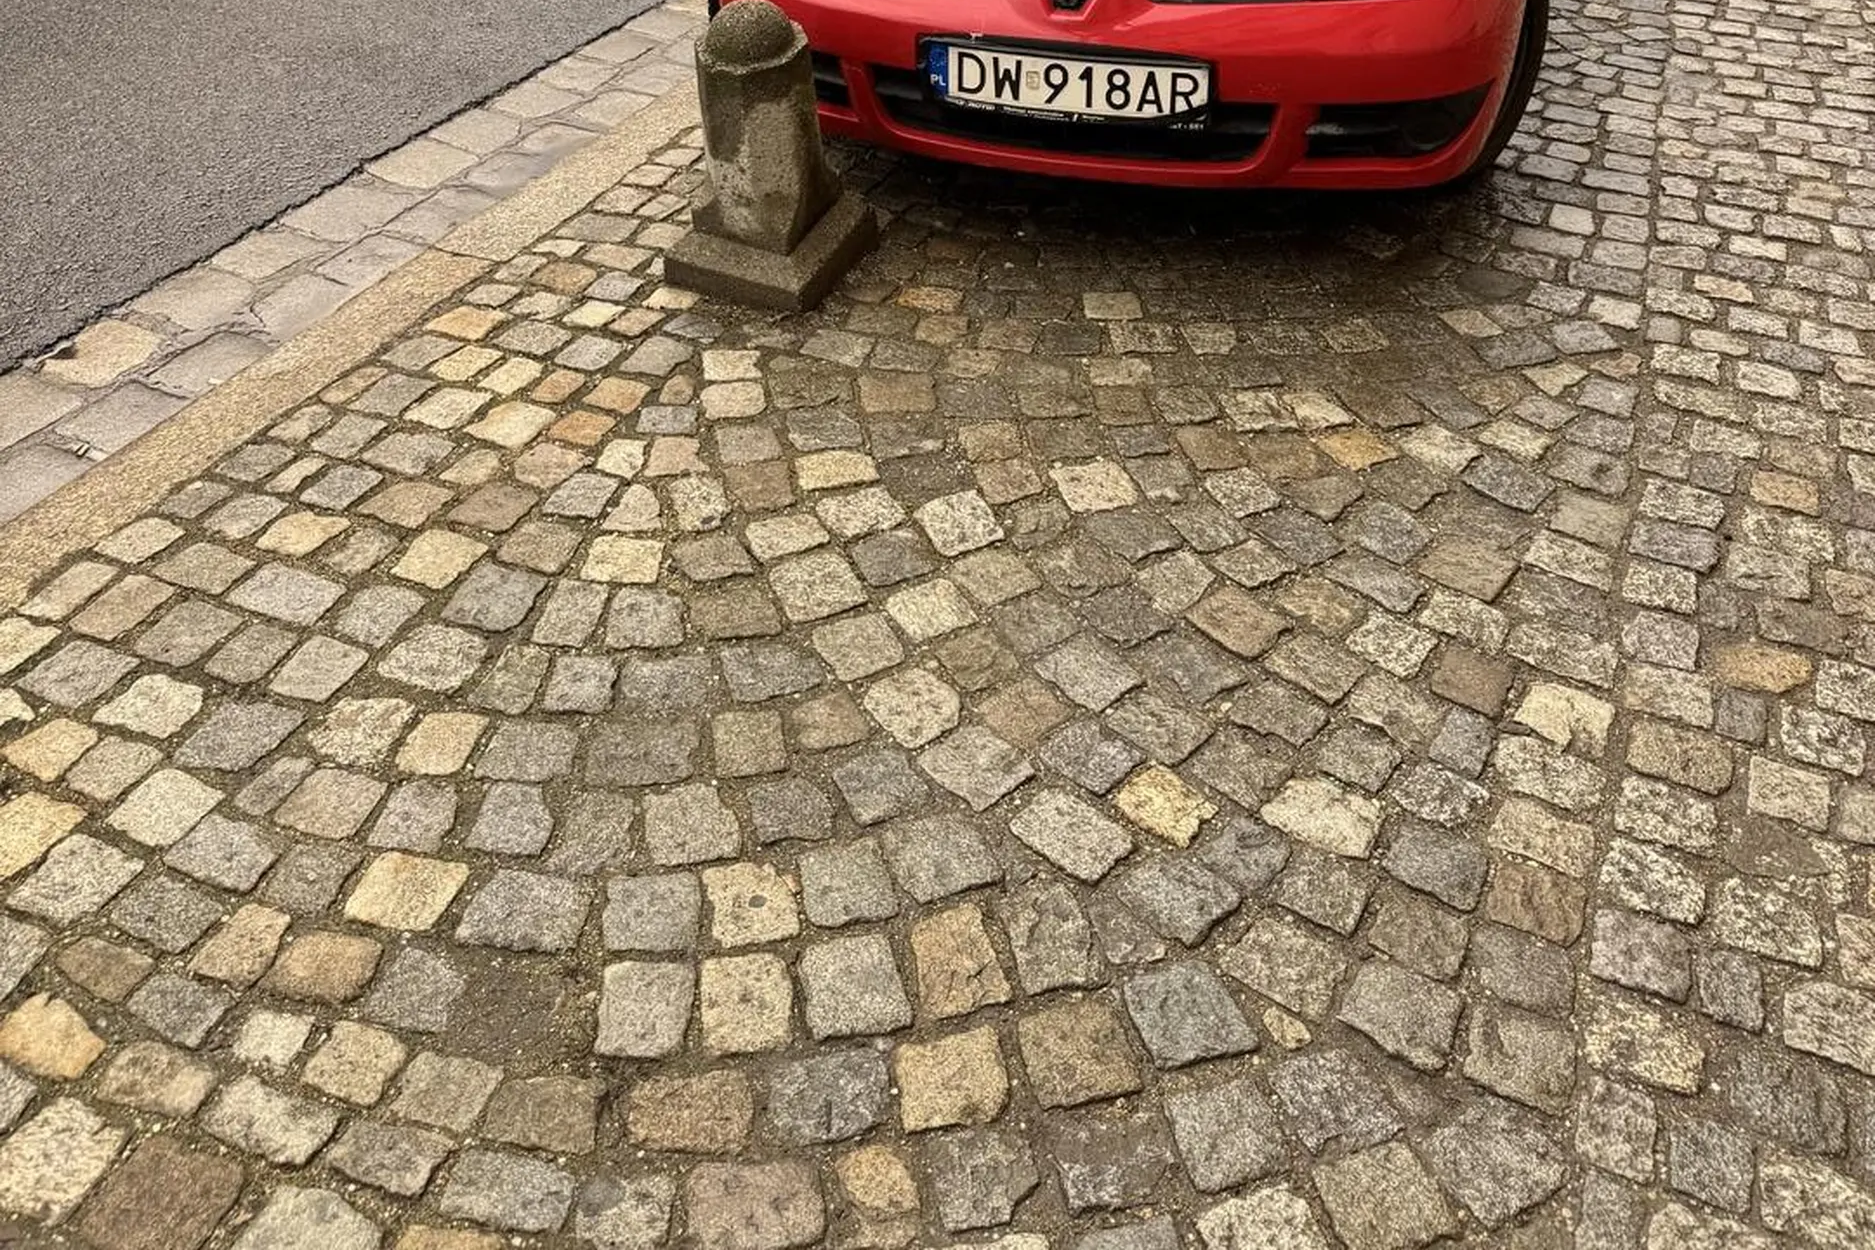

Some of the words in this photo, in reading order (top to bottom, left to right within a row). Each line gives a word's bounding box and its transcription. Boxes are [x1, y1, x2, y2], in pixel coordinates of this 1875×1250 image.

[930, 73, 946, 86] PL
[957, 51, 1022, 101] DW
[1044, 62, 1200, 114] 918AR
